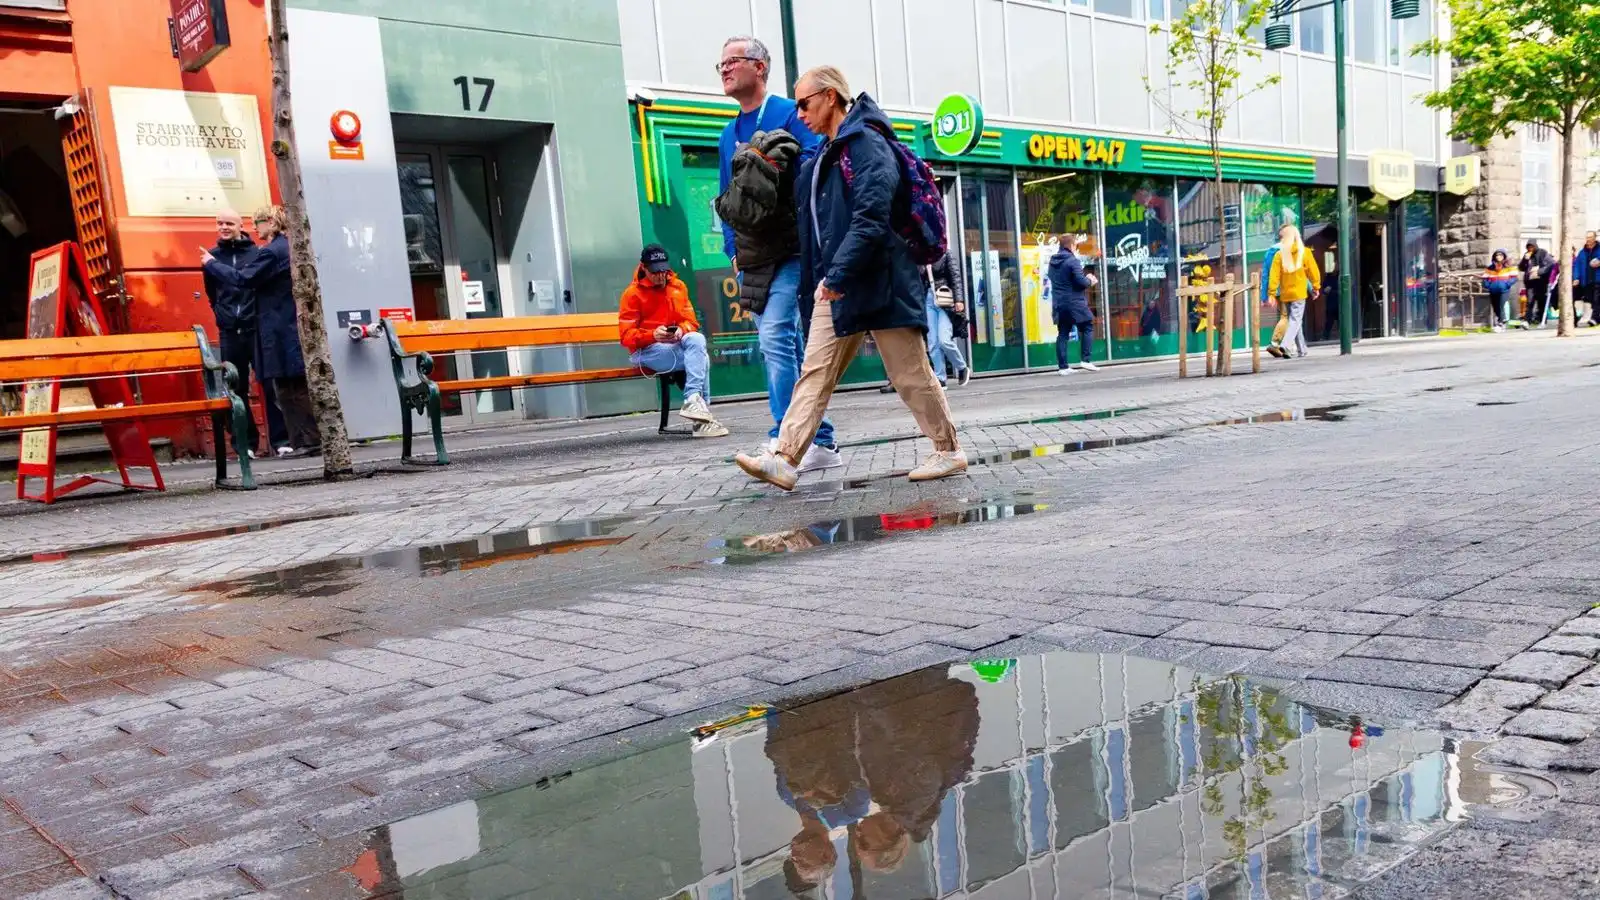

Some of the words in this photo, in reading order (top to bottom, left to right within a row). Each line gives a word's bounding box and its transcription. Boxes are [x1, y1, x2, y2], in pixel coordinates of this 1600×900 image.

[453, 75, 495, 112] 17
[136, 121, 218, 137] STAIRWAY
[221, 126, 243, 138] TO
[136, 134, 181, 147] FOOD
[184, 136, 247, 150] HEAVEN
[1028, 133, 1082, 161] OPEN
[1084, 138, 1127, 165] 24/7
[216, 161, 234, 170] 365
[1116, 245, 1150, 271] SBARRO
